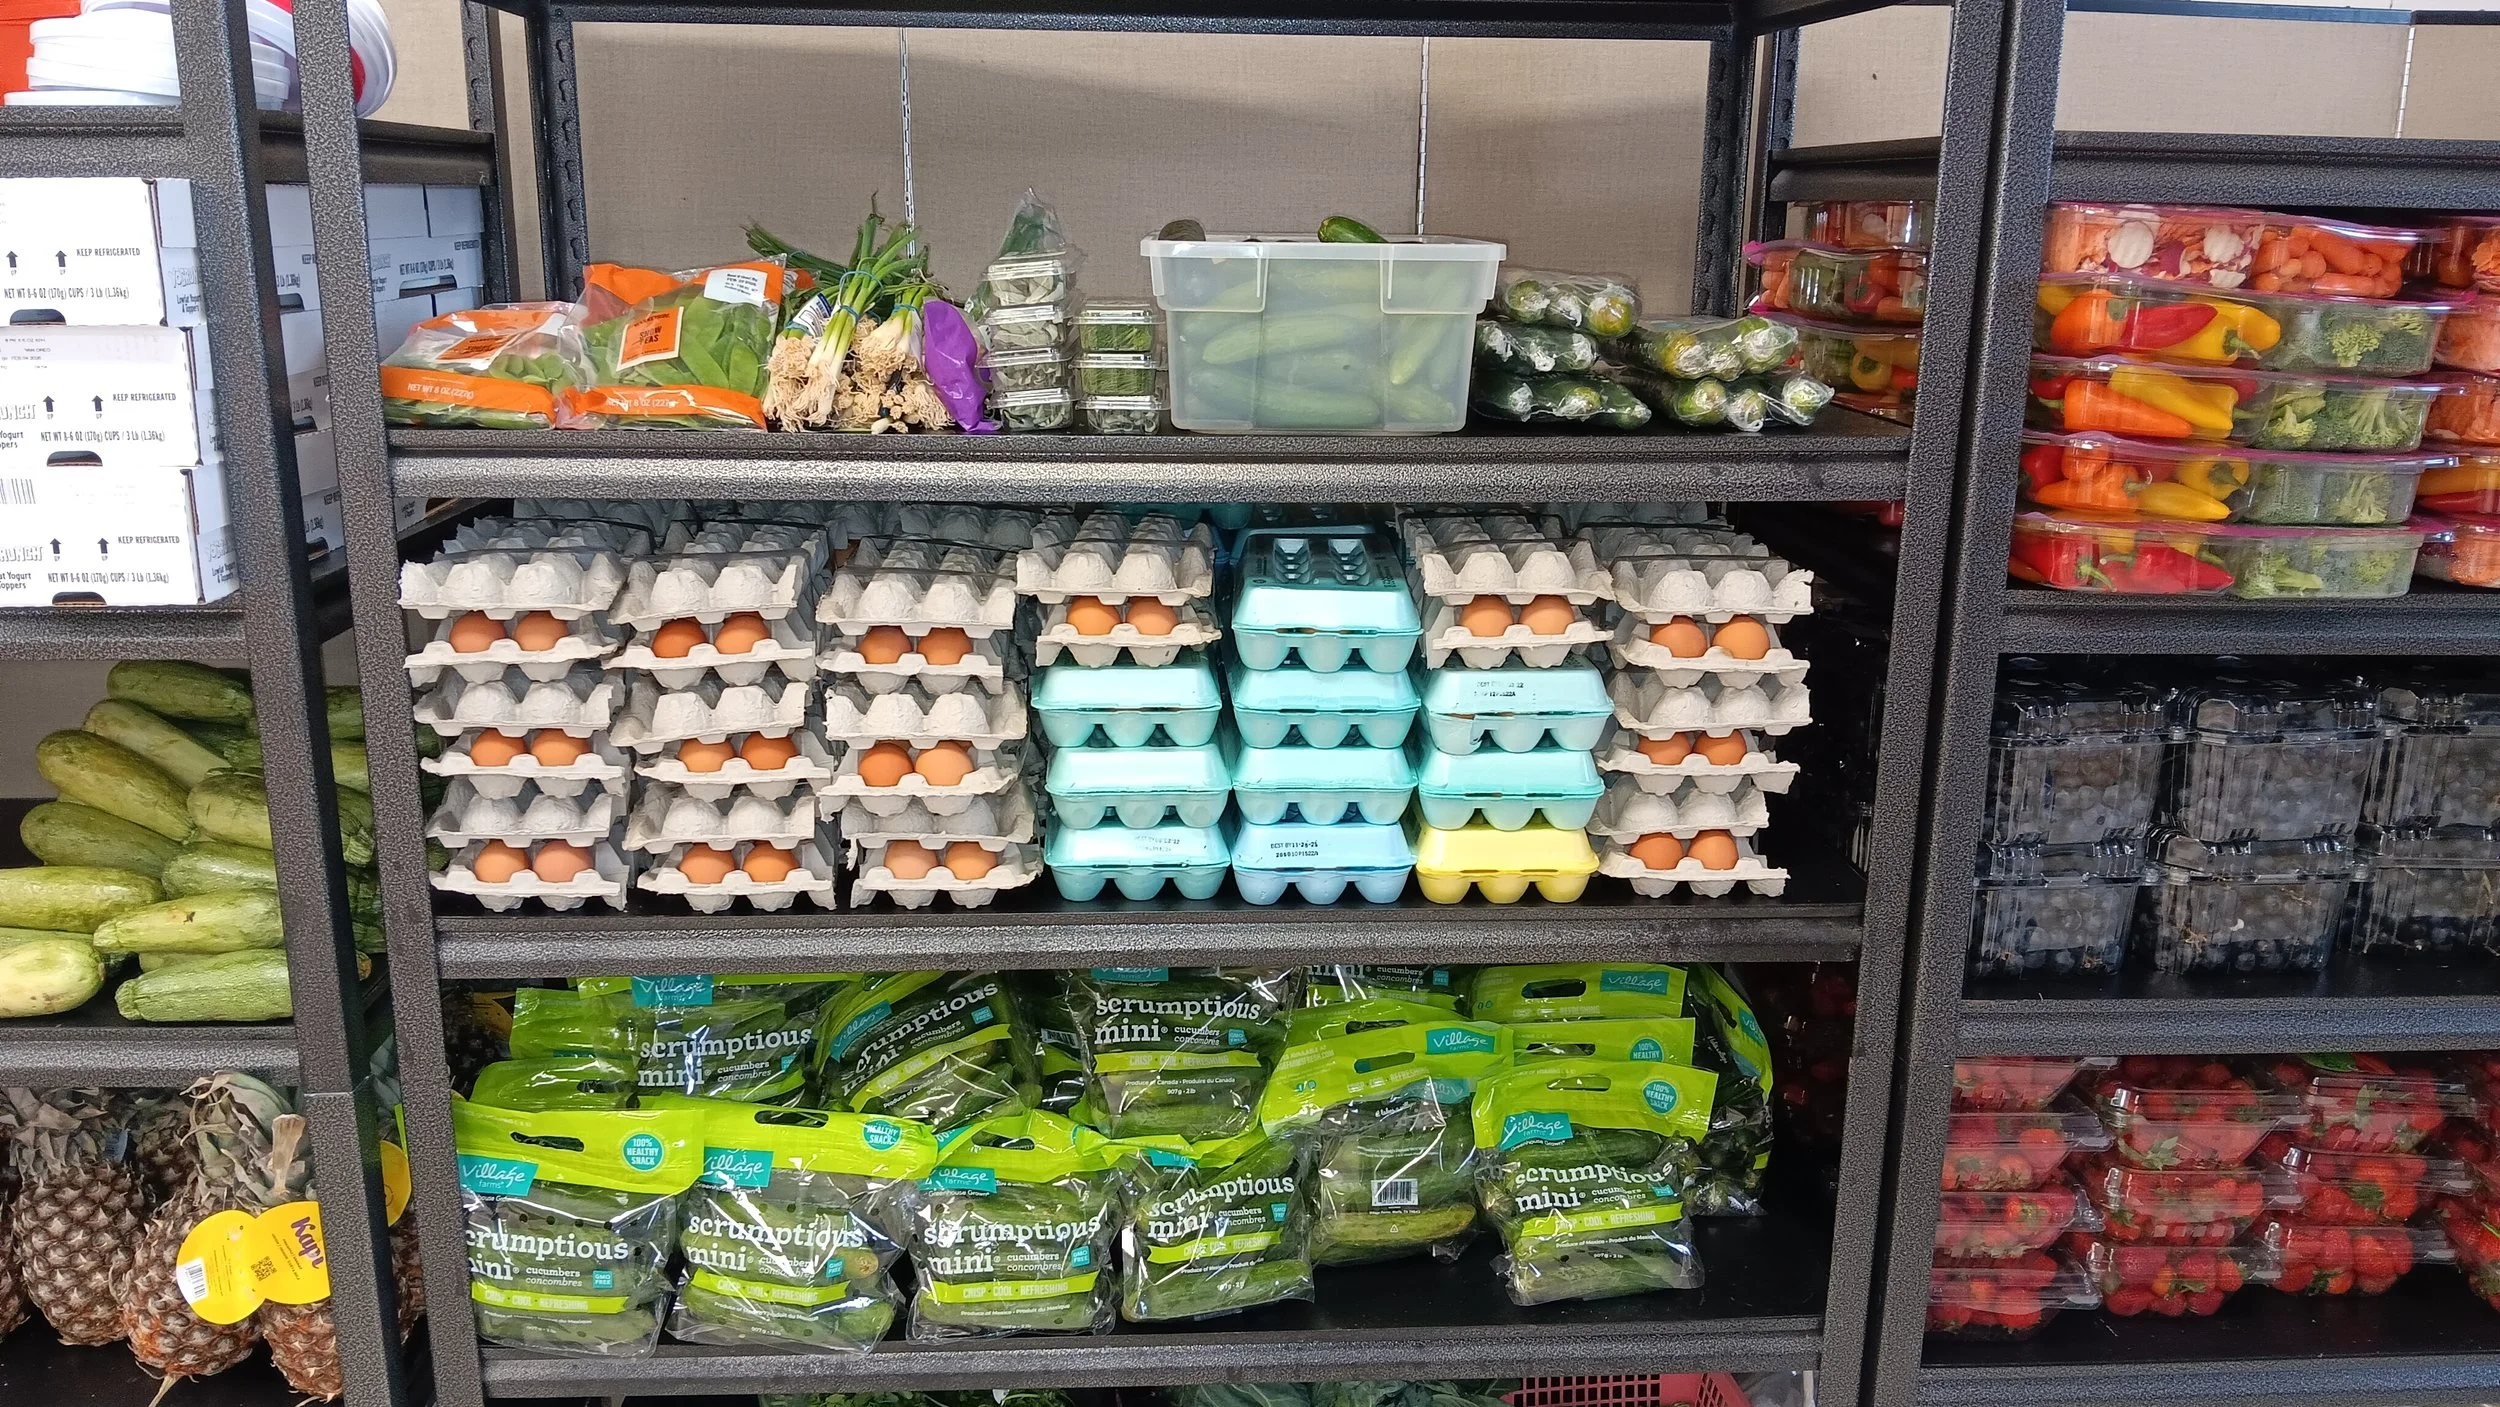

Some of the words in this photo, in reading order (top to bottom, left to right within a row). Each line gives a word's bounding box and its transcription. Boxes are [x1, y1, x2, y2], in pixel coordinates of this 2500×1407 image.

[76, 248, 94, 257] KEEP
[94, 247, 141, 257] REFRIGERATED
[4, 288, 16, 299] NET
[16, 288, 26, 299] WT
[39, 288, 47, 299] OZ
[68, 287, 84, 299] CUPS
[639, 325, 662, 338] SNOW
[407, 383, 422, 393] NET
[422, 384, 433, 395] WT
[433, 386, 440, 395] 8
[440, 386, 451, 396] OZ
[112, 393, 129, 402] KEEP
[130, 392, 176, 402] REFRIGERATED
[40, 431, 52, 442] NET
[53, 431, 63, 442] WT
[75, 431, 83, 441] OZ
[104, 430, 120, 441] CUPS
[118, 536, 134, 545] KEEP
[135, 535, 180, 545] REFRIGERATED
[7, 571, 31, 583] Yogurt
[48, 572, 59, 583] NET
[60, 572, 69, 583] WT
[82, 572, 90, 583] OZ
[110, 571, 126, 583] CUPS
[1376, 966, 1424, 976] cucumbers
[1376, 974, 1425, 985] concombres
[1608, 974, 1663, 990] Village
[639, 975, 707, 1000] Village
[1095, 995, 1261, 1021] scrumptious
[909, 1019, 962, 1044] cucumbers
[1094, 1017, 1161, 1044] mini
[1174, 1026, 1221, 1036] cucumbers
[639, 1027, 812, 1061] scrumptious
[911, 1025, 966, 1050] concombres
[1174, 1035, 1220, 1046] concombres
[1433, 1031, 1489, 1049] Village
[1638, 1042, 1655, 1051] 100%
[1633, 1050, 1661, 1060] HEALTHY
[637, 1058, 705, 1087] mini
[717, 1060, 770, 1074] cucumbers
[717, 1068, 772, 1083] concombres
[1157, 1078, 1179, 1086] Canada
[1214, 1076, 1236, 1084] Canada
[1653, 1083, 1670, 1094] 100%
[883, 1091, 907, 1109] Produce
[1645, 1090, 1675, 1104] HEALTHY
[1504, 1114, 1565, 1136] Village
[632, 1138, 653, 1148] 100%
[869, 1133, 894, 1145] SNACK
[626, 1146, 660, 1157] HEALTHY
[631, 1156, 655, 1166] SNACK
[461, 1162, 526, 1188] Village
[1514, 1160, 1674, 1189] scrumptious
[478, 1179, 503, 1189] farms
[1148, 1173, 1295, 1217] scrumptious
[1514, 1185, 1581, 1213] mini
[1147, 1205, 1209, 1239] mini
[1218, 1207, 1263, 1217] cucumbers
[1583, 1213, 1605, 1226] COOL
[1609, 1210, 1656, 1225] REFRESHING
[688, 1215, 864, 1252] scrumptious
[290, 1216, 324, 1270] Kapi
[465, 1229, 629, 1261] crumptious
[686, 1242, 747, 1272] mini
[1073, 1249, 1088, 1257] GMO
[927, 1247, 994, 1275] mini
[1006, 1252, 1060, 1262] cucumbers
[1006, 1261, 1062, 1272] concombres
[525, 1266, 581, 1278] cucumbers
[525, 1276, 583, 1288] concombres
[963, 1287, 986, 1298] CRISP
[993, 1285, 1013, 1297] COOL
[1020, 1282, 1069, 1296] REFRESHING
